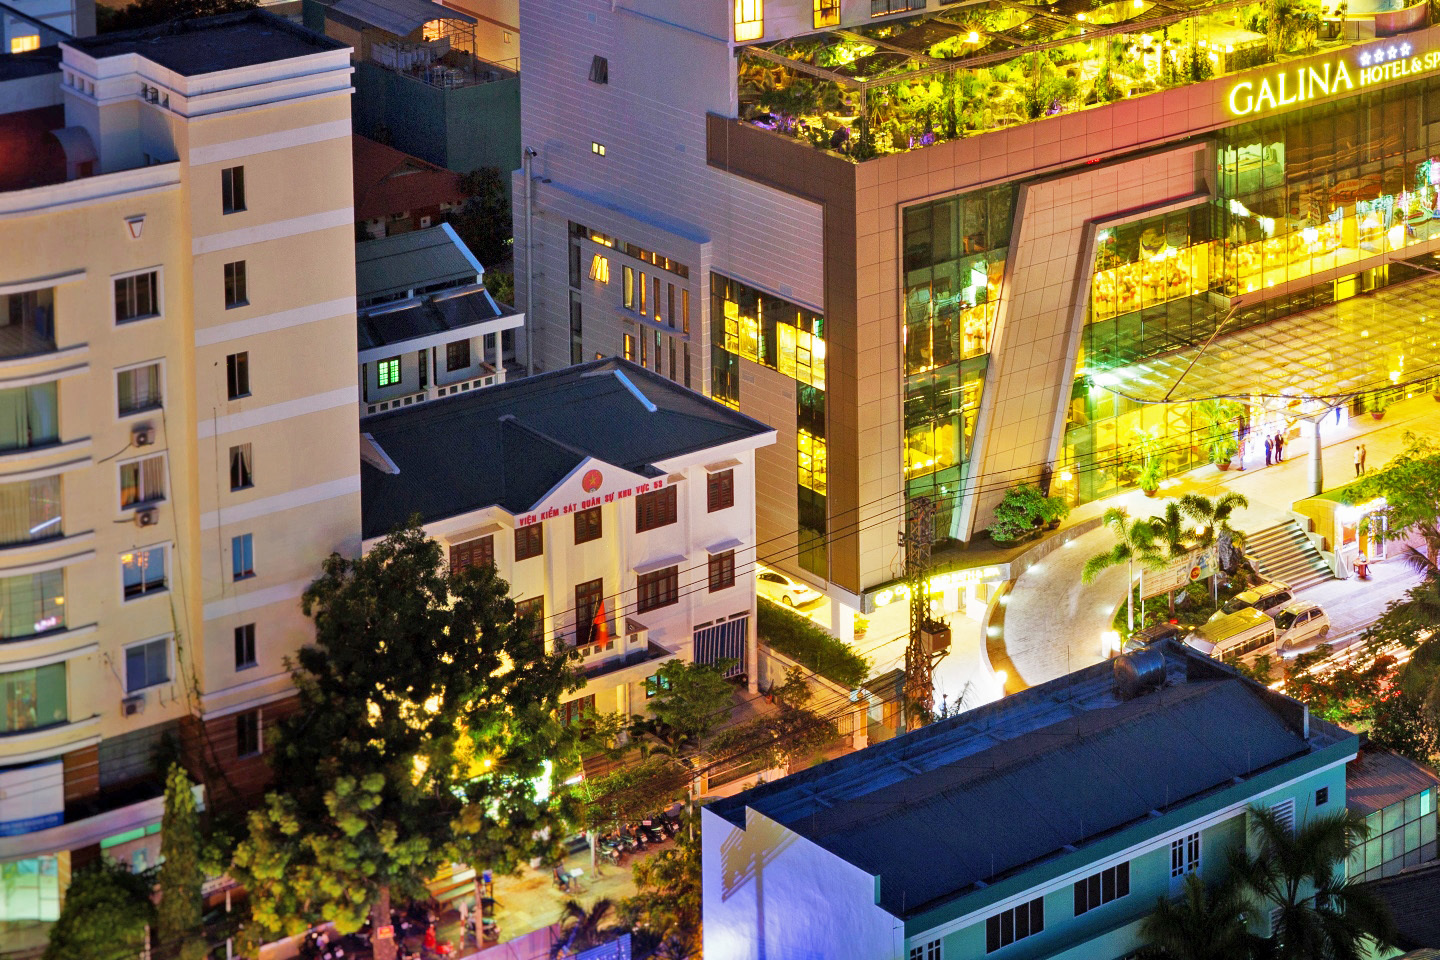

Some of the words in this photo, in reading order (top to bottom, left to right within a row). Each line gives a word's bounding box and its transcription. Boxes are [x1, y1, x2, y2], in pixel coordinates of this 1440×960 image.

[1228, 59, 1354, 116] GALINA
[1360, 58, 1410, 86] HOTEL
[519, 513, 537, 527] VIỆN
[563, 502, 577, 514] SÁT
[582, 496, 601, 509] QUÂN
